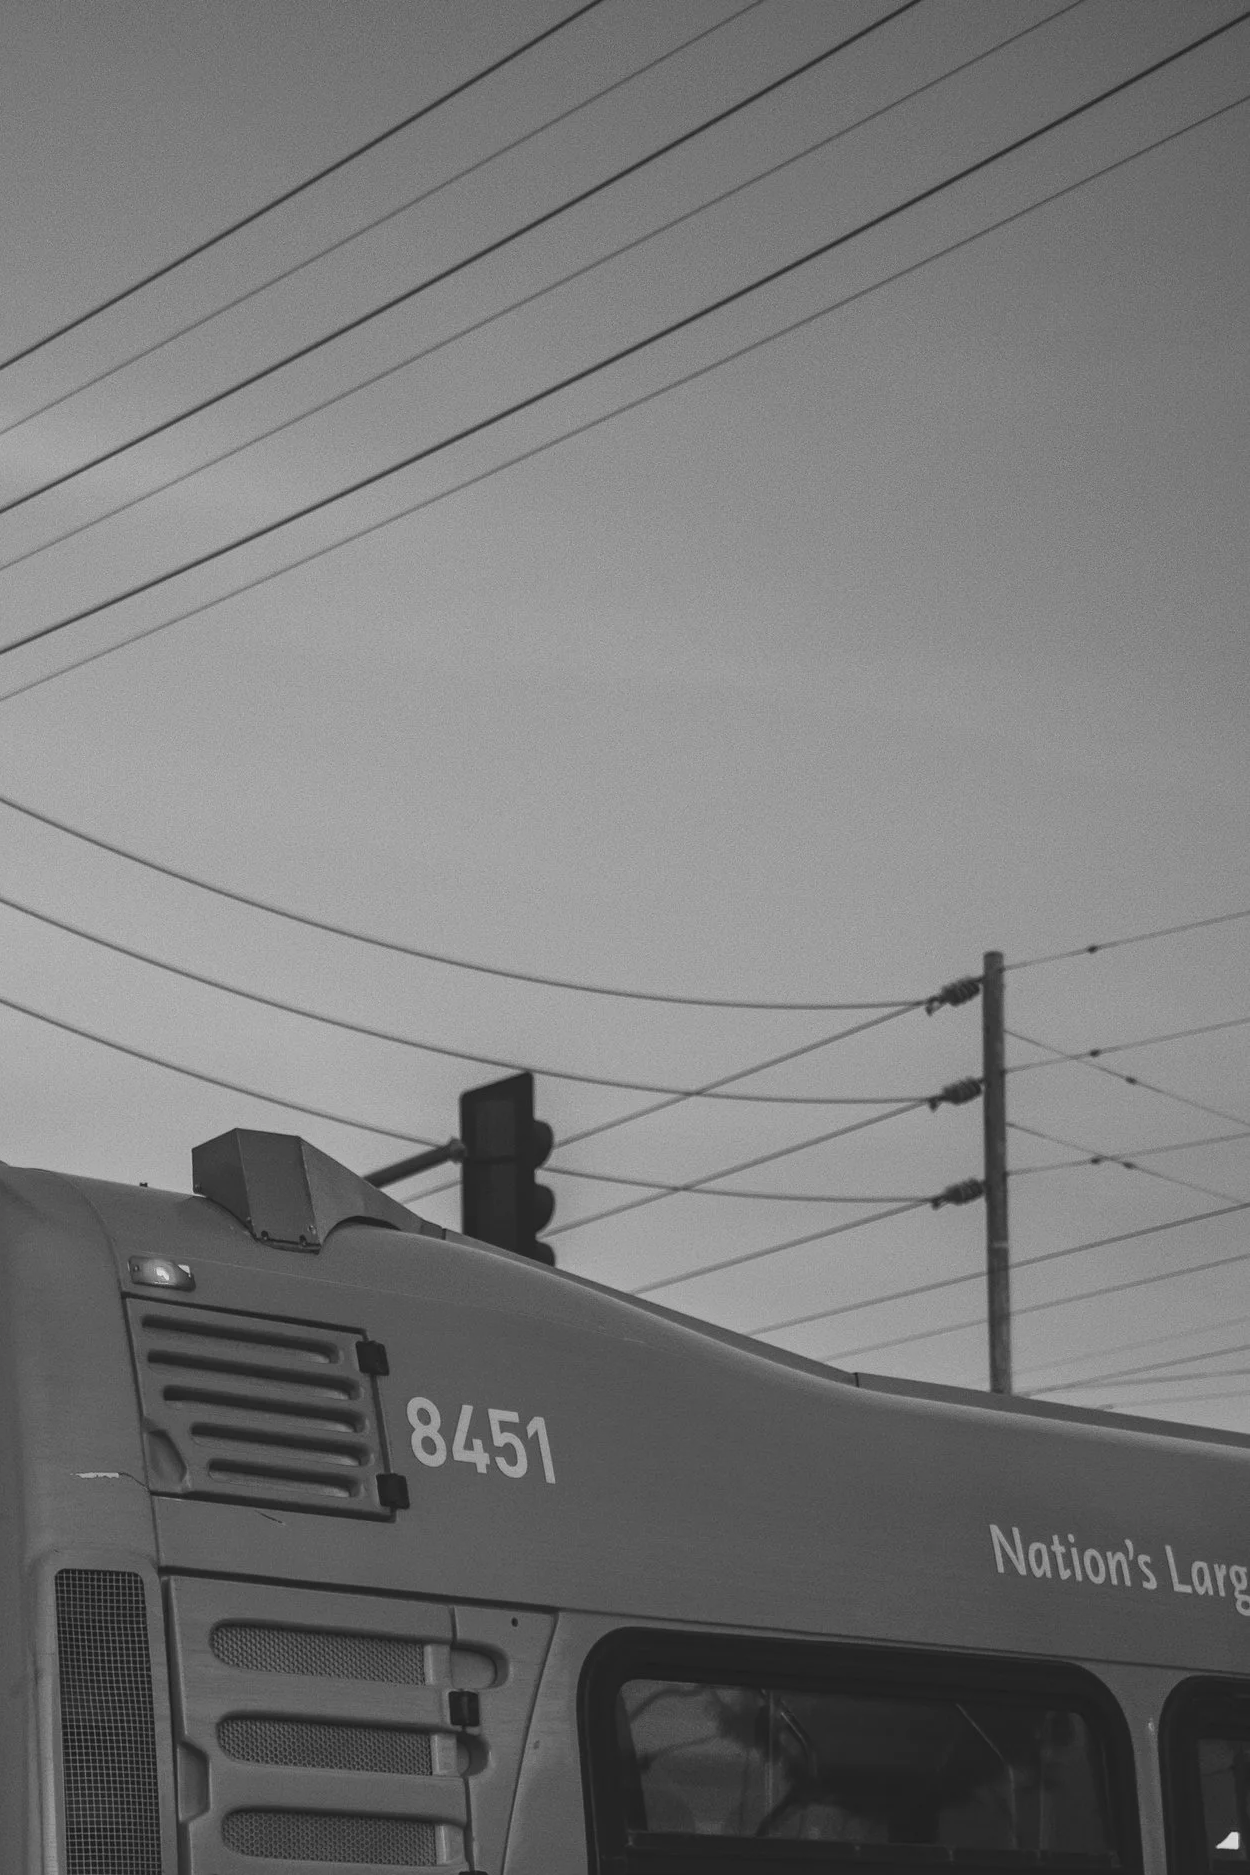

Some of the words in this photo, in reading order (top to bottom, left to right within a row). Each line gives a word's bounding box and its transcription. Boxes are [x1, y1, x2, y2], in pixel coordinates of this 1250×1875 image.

[406, 1396, 557, 1485] 8451
[989, 1523, 1158, 1591] Nation's
[1164, 1544, 1250, 1617] Larg
